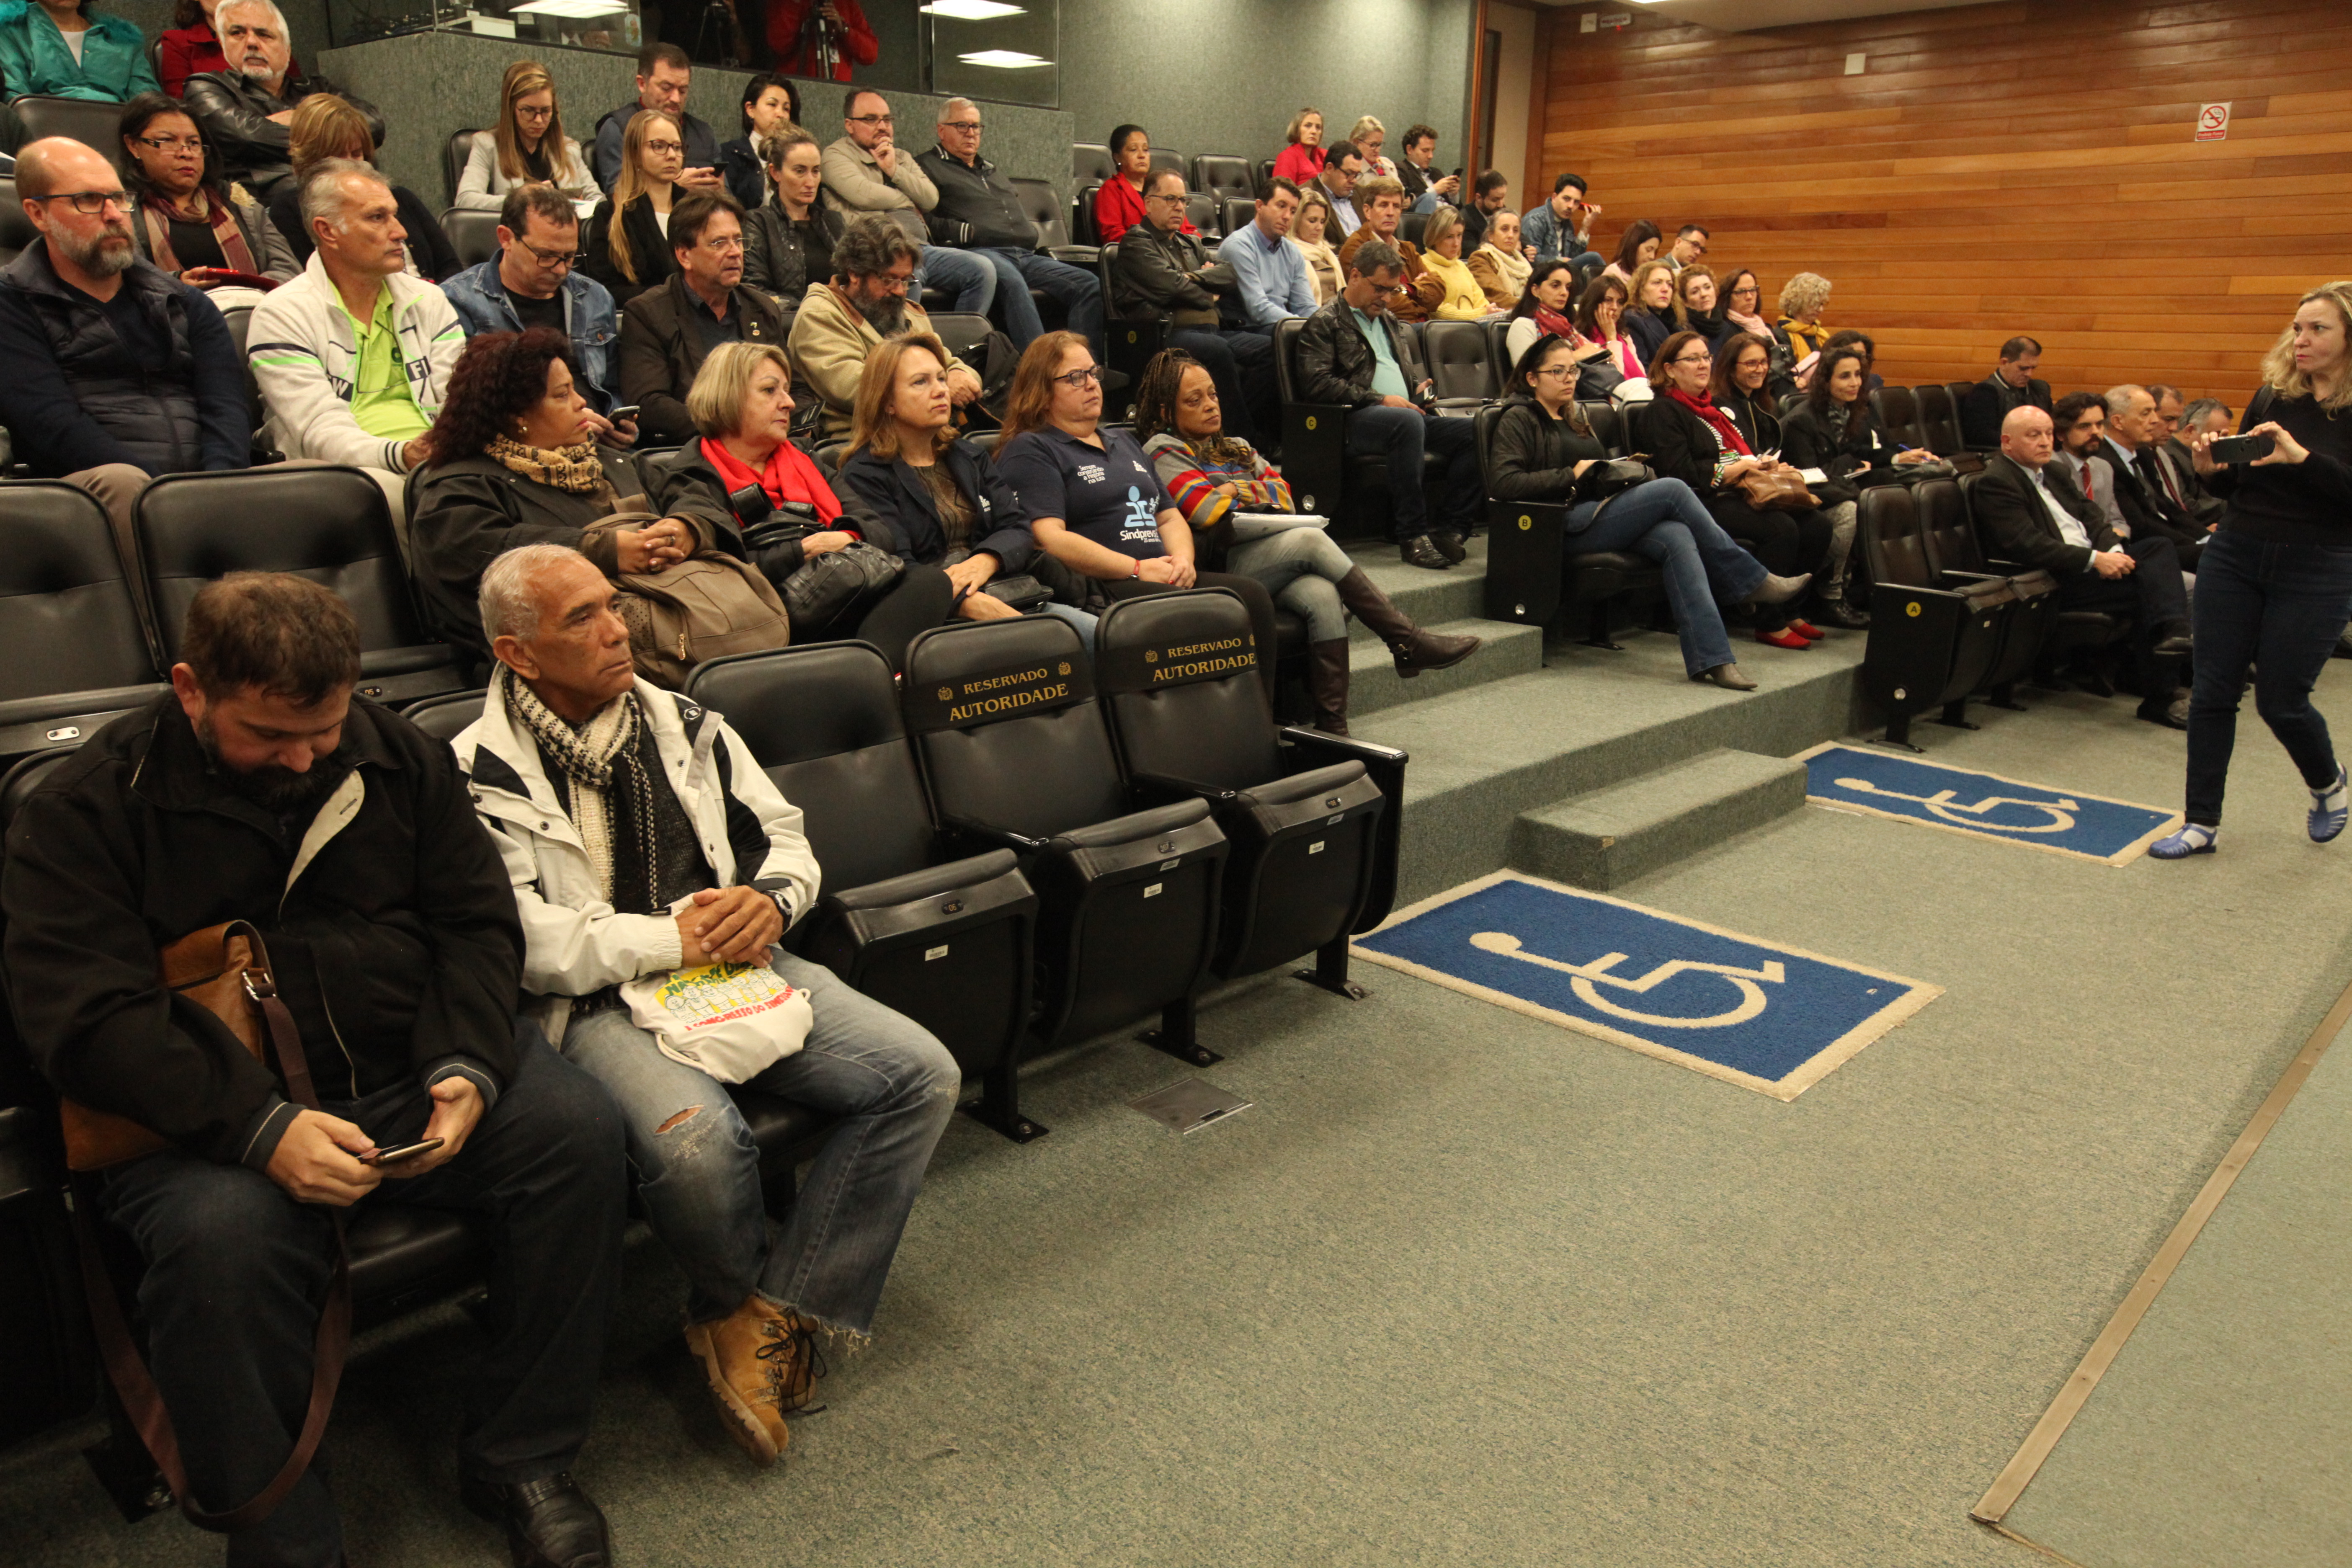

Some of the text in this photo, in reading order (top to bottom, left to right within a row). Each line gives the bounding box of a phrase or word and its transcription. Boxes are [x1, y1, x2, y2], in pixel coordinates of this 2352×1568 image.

[1167, 638, 1242, 658] RESERVADO
[963, 668, 1048, 694] RESERVADO
[1153, 653, 1256, 682] AUTORIDADE
[949, 683, 1068, 721] AUTORIDADE
